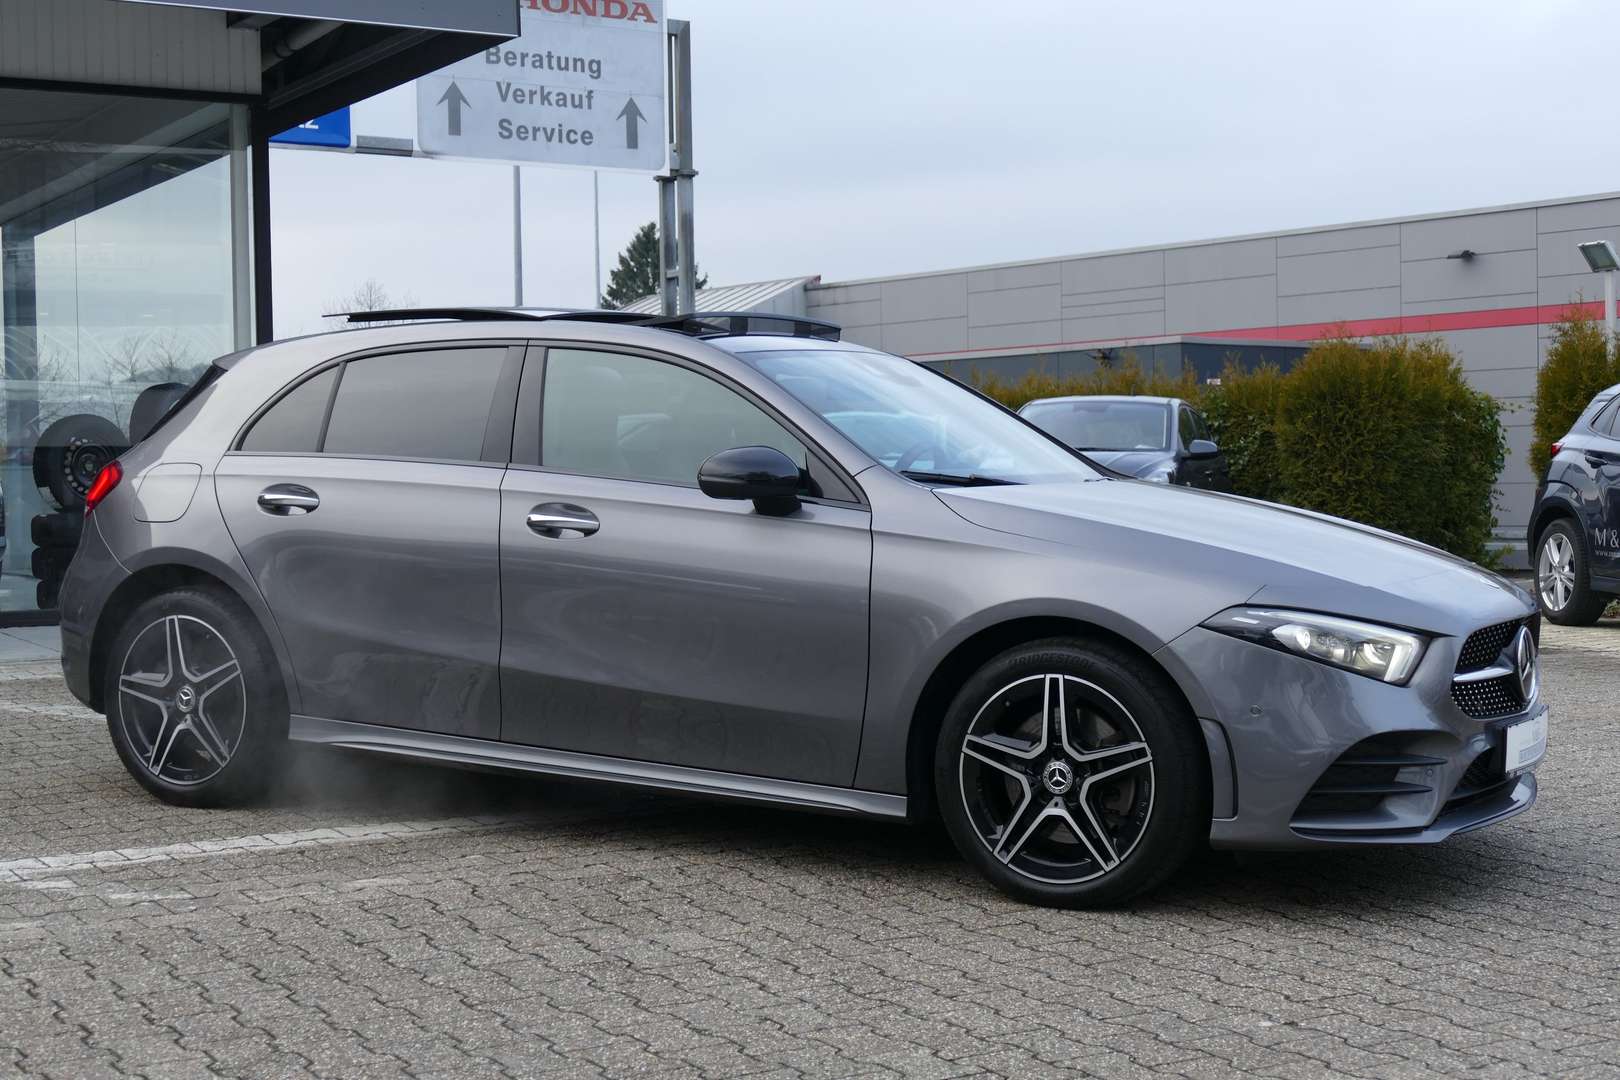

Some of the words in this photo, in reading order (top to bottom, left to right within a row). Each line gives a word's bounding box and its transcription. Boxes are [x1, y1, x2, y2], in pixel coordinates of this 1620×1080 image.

[485, 46, 602, 80] Beratung
[496, 81, 594, 110] Verkauf
[498, 118, 594, 146] Service
